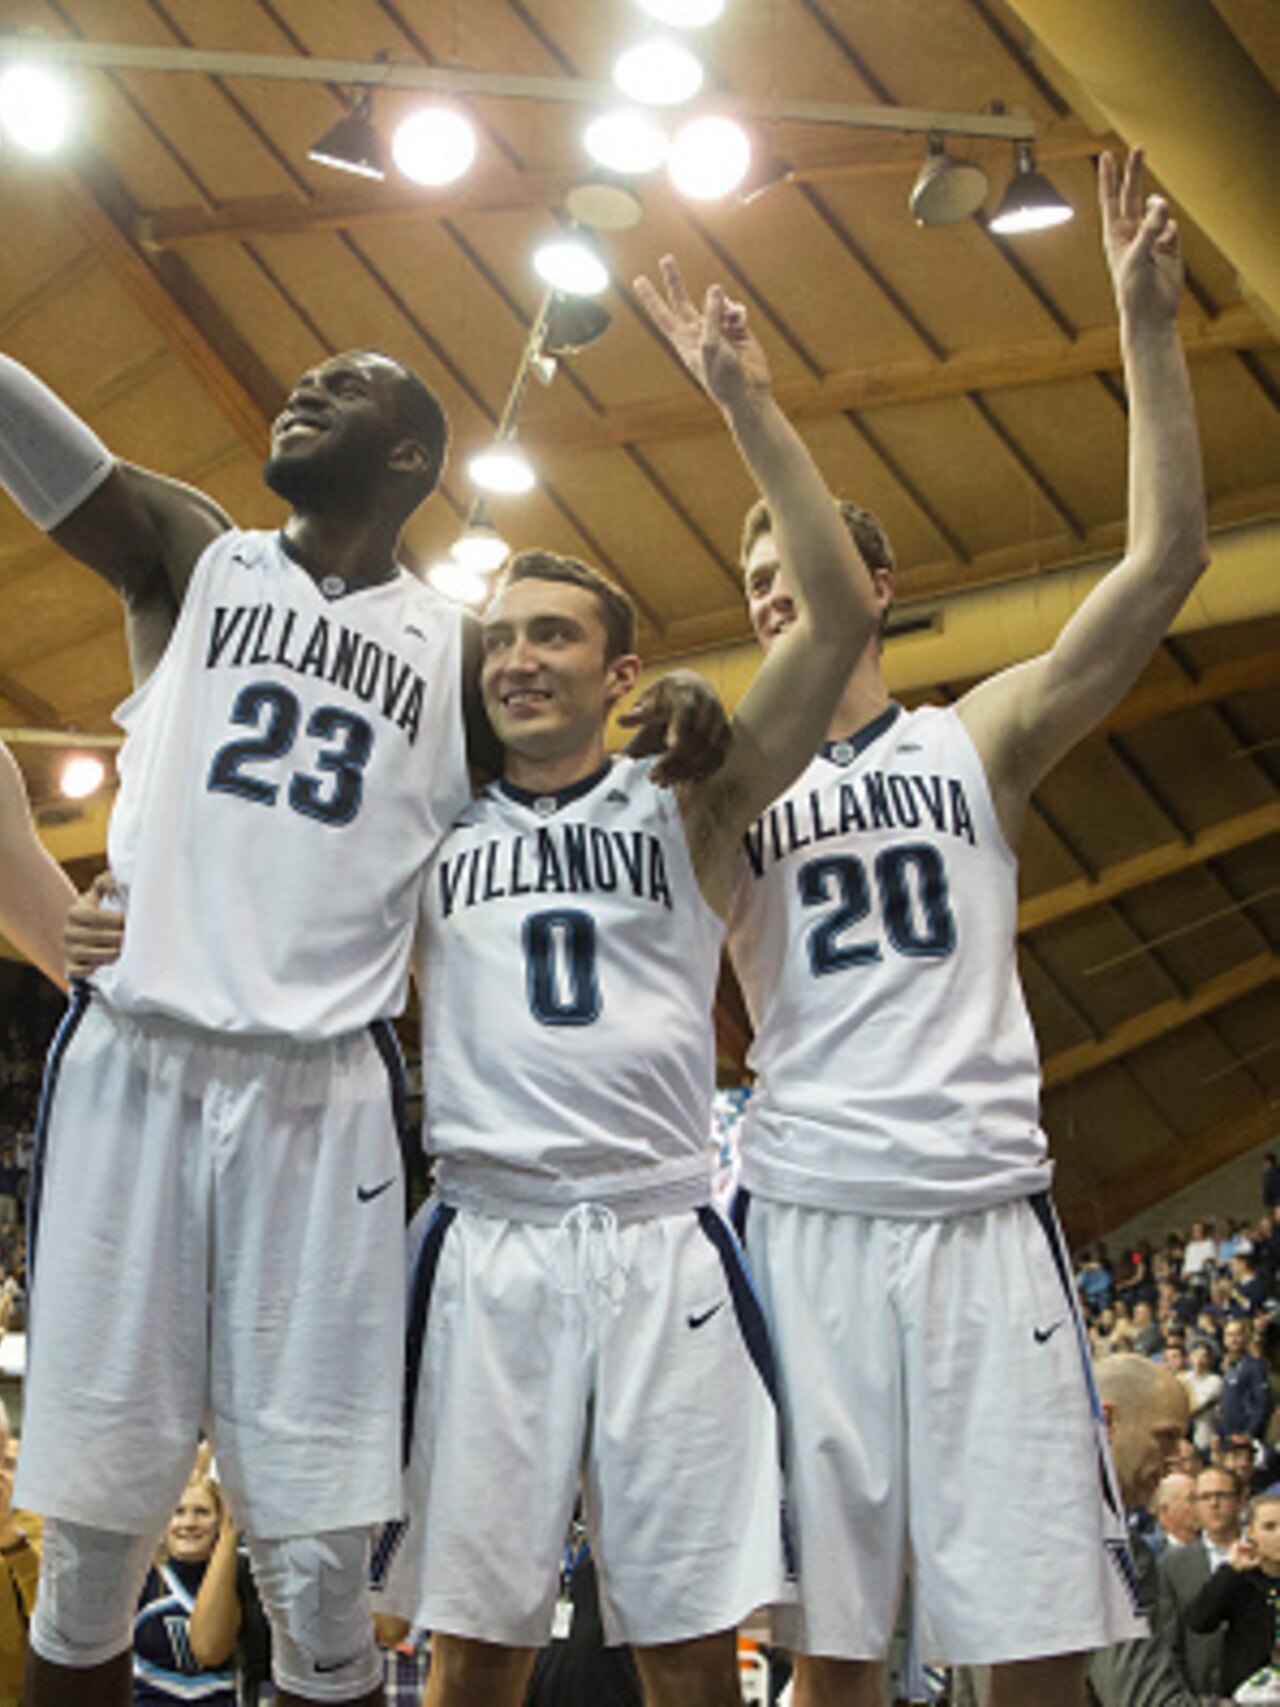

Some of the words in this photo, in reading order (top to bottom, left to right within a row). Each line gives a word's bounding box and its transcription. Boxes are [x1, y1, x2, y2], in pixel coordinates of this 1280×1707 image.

[206, 602, 426, 748] VILLANOVA
[207, 680, 374, 827] 23
[439, 822, 674, 919] VILLANOVA
[744, 771, 977, 880] VILLANOVA
[523, 907, 604, 1027] 0
[797, 841, 958, 979] 20
